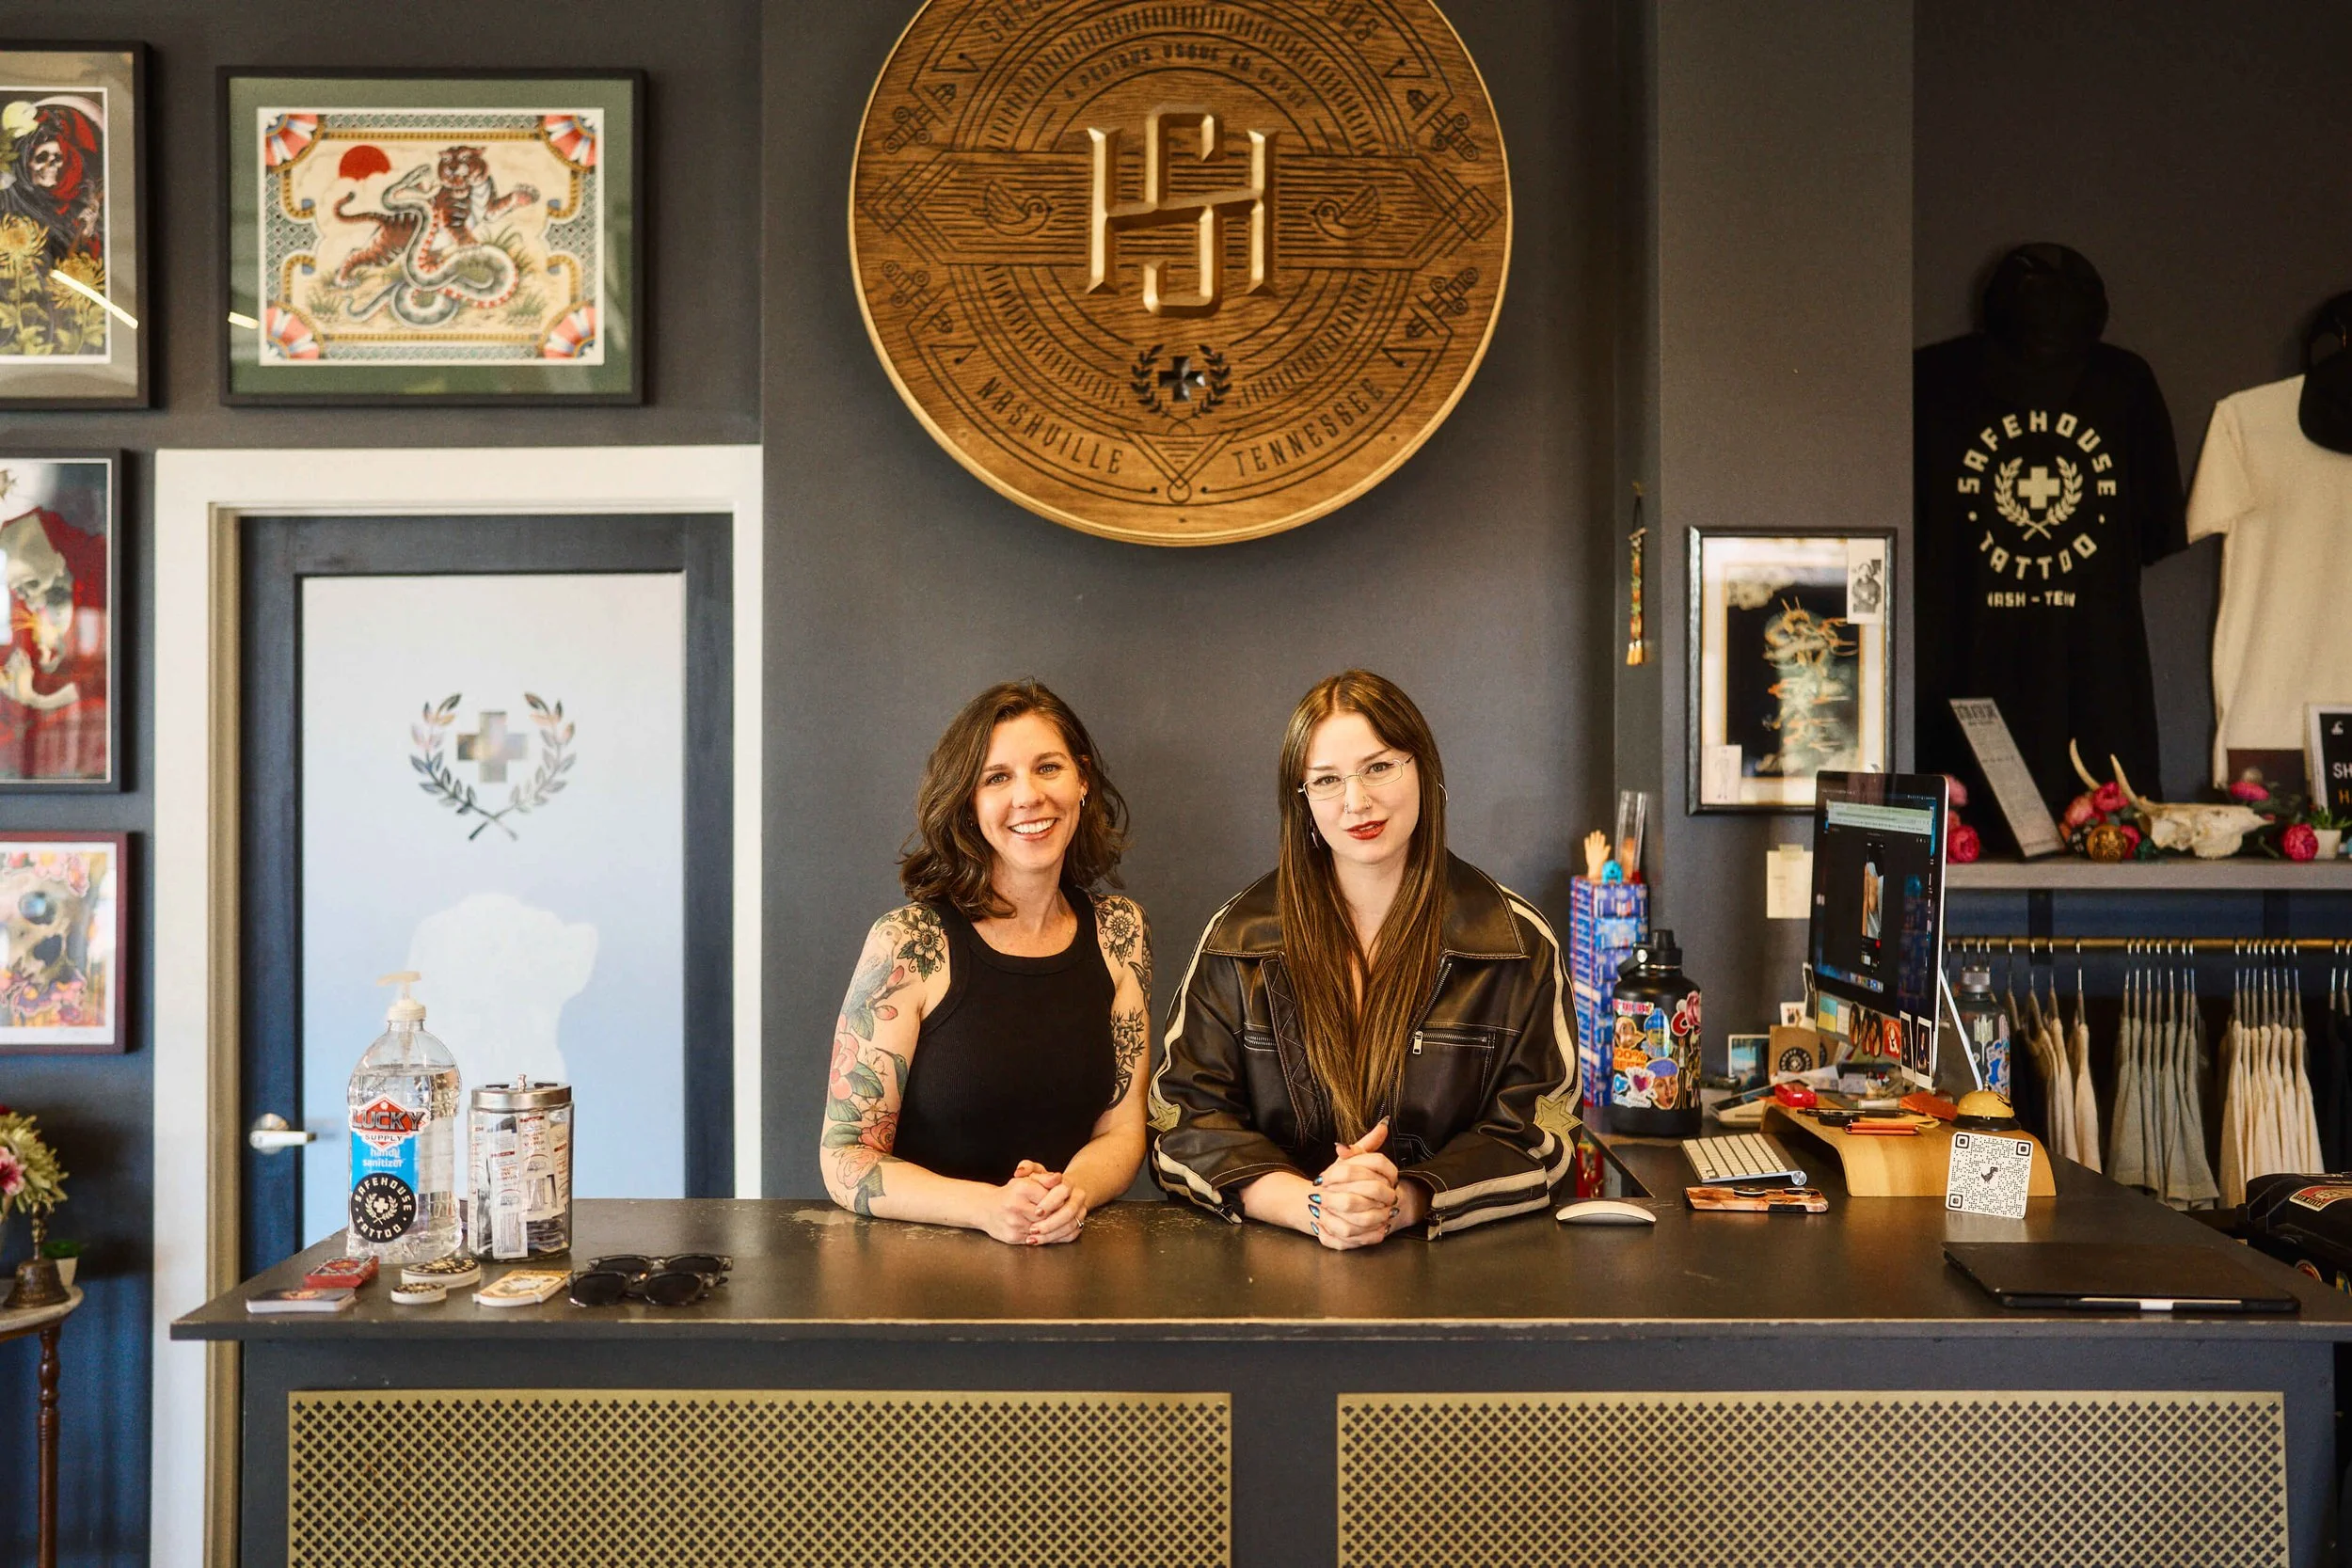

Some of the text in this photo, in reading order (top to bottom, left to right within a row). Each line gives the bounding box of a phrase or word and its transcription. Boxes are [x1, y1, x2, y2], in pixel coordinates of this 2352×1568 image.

[976, 376, 1385, 477] NASHVILLE TENNESSEE
[1957, 410, 2117, 497] SAFEHOUSE
[1979, 530, 2098, 580] TATTOO
[352, 1108, 426, 1132] LUCKY
[364, 1133, 403, 1142] SUPPLY
[362, 1158, 403, 1167] sanitizer
[354, 1177, 412, 1212] SAFEHOUSE
[357, 1216, 402, 1239] TATTOO
